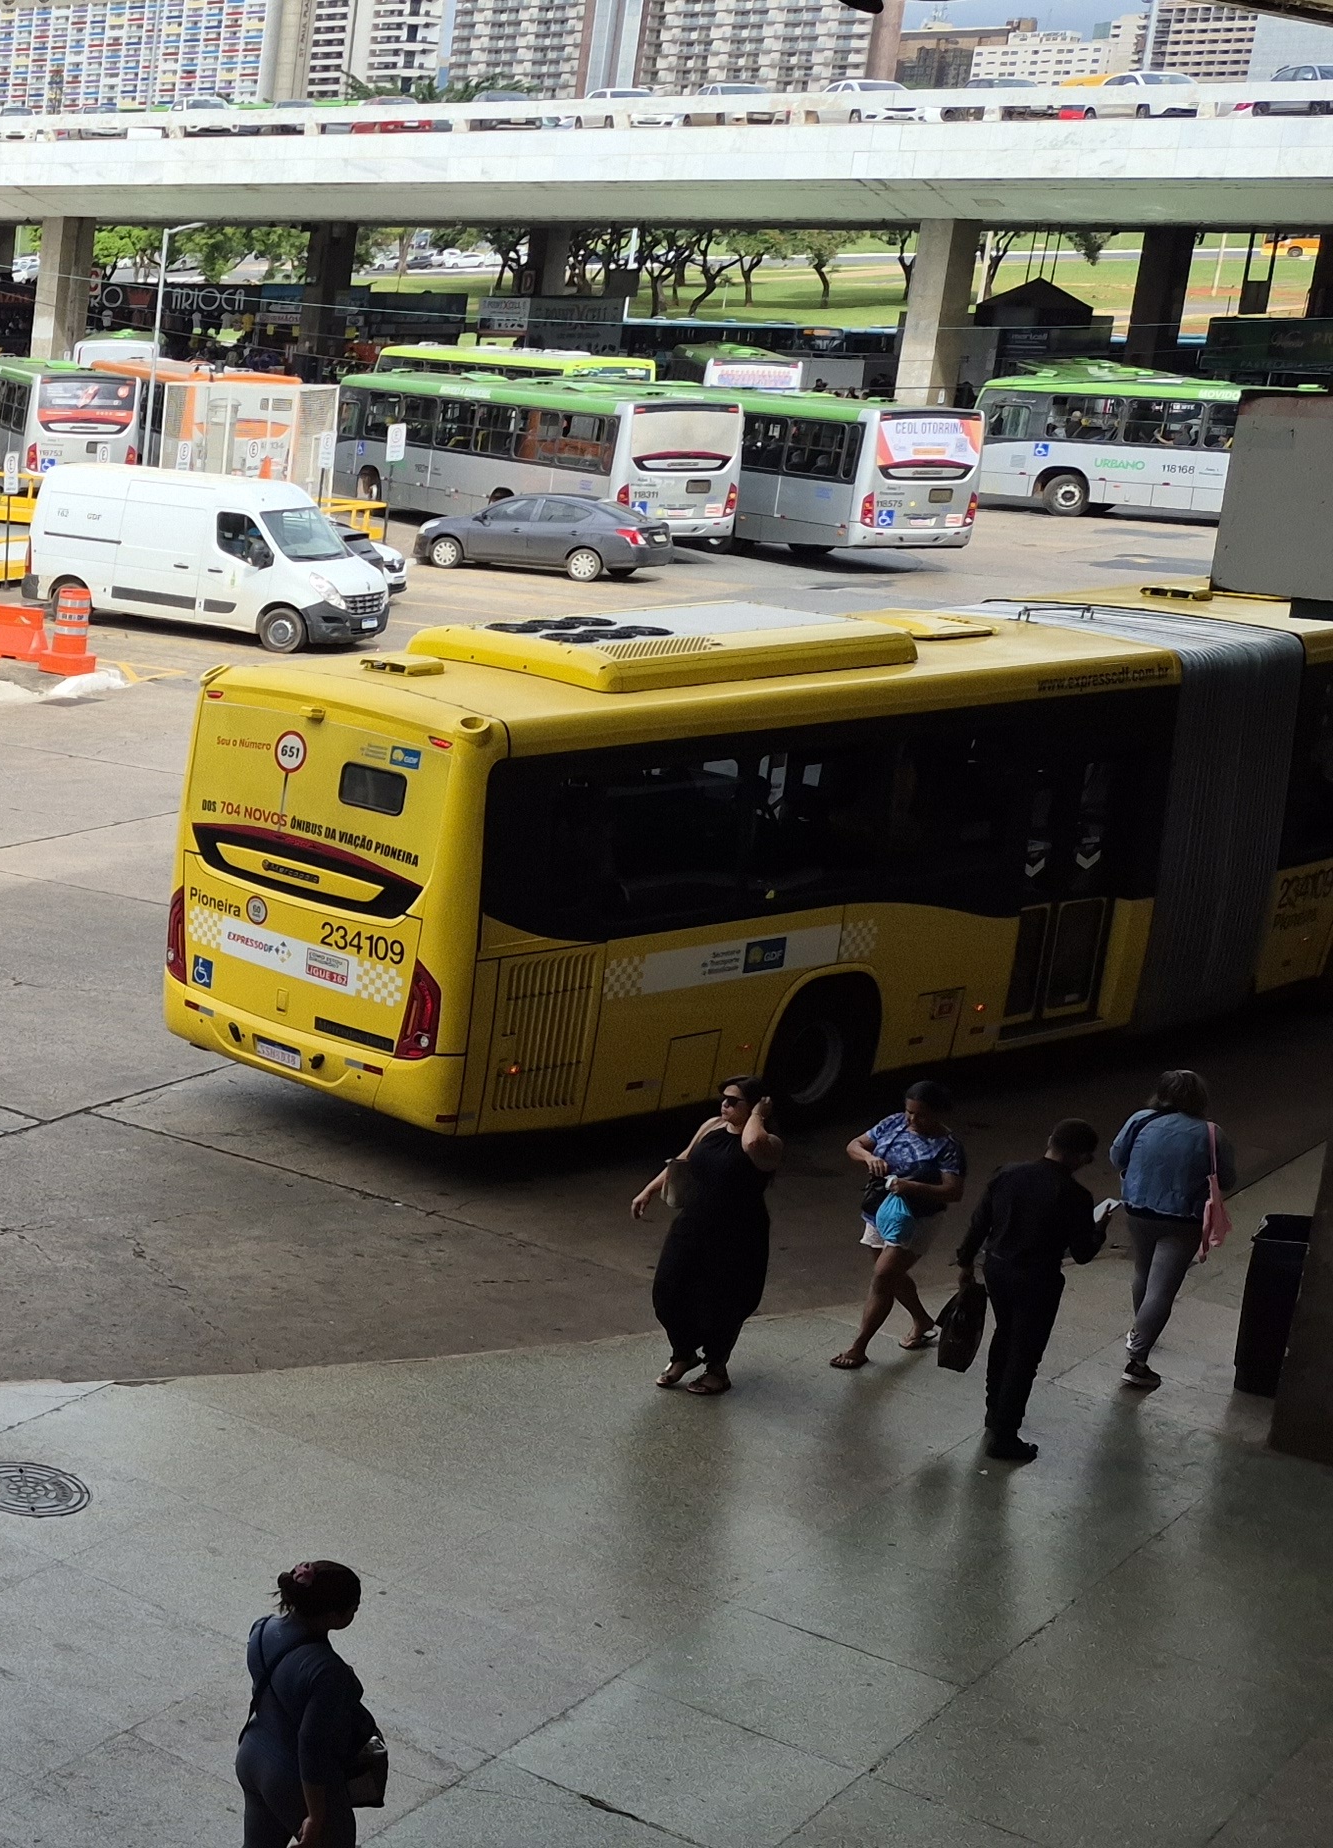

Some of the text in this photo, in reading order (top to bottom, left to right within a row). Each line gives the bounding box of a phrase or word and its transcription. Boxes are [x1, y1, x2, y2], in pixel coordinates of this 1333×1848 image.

[165, 288, 245, 311] ARIOCA
[1094, 457, 1146, 470] URBANO
[1161, 464, 1195, 474] 118168
[216, 735, 231, 747] Sou
[238, 737, 272, 752] Número
[280, 744, 300, 760] 651
[202, 799, 420, 868] DOS 704 NOVOS ÔNIBUS DA VIAÇÃO PIONEIRA
[189, 886, 241, 918] Pioneira
[319, 922, 405, 966] 234109
[763, 949, 784, 962] GDF
